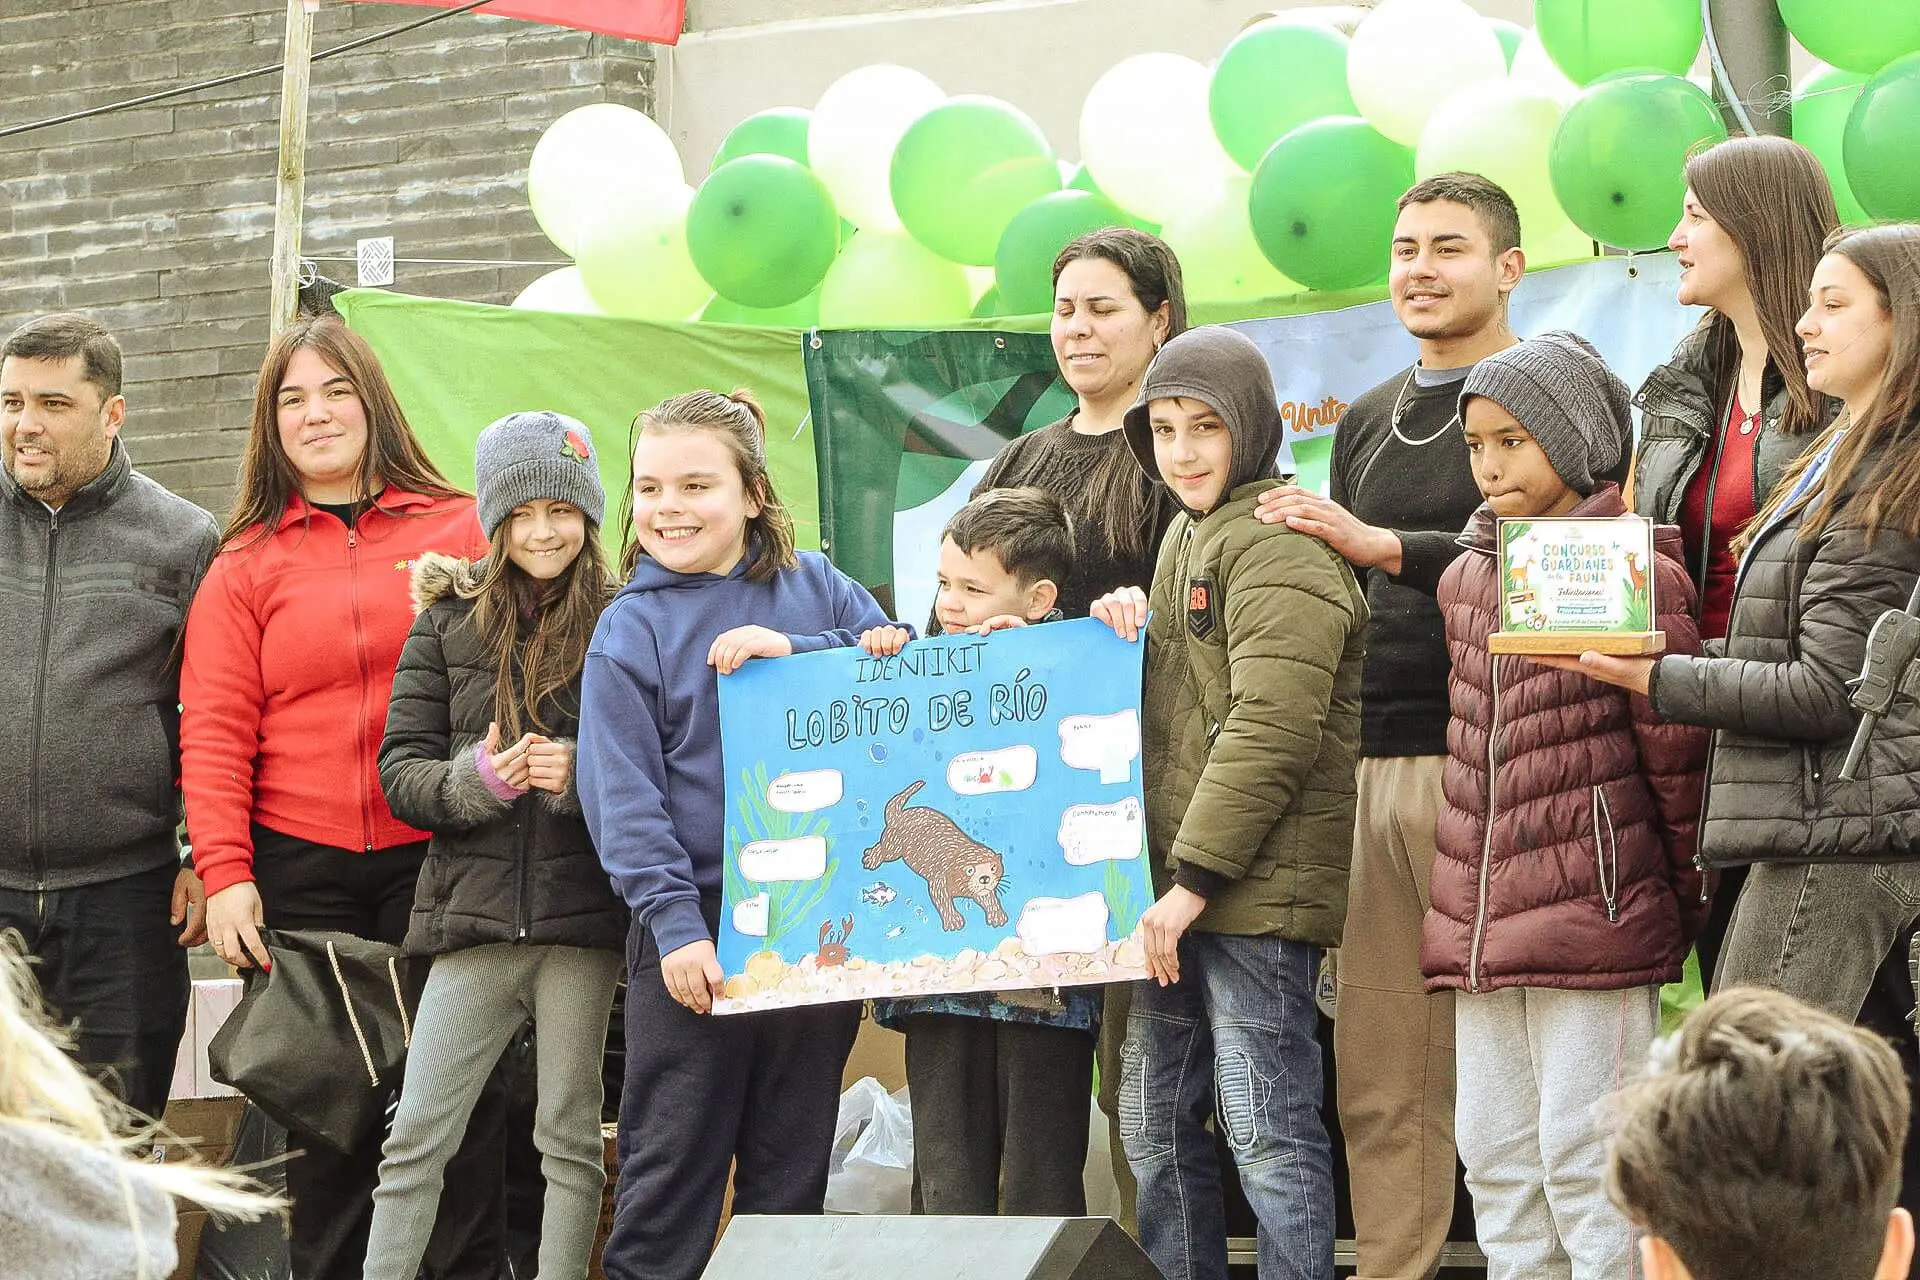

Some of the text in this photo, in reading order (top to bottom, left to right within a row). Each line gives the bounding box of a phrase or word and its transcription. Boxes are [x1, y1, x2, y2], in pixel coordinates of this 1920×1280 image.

[1543, 543, 1606, 557] CONCURSO
[1541, 557, 1614, 571] GUARDIANES
[1569, 571, 1606, 583] FAUNA
[856, 642, 989, 683] IDENTIKIT
[928, 690, 974, 732] DE
[989, 668, 1048, 726] RÍO
